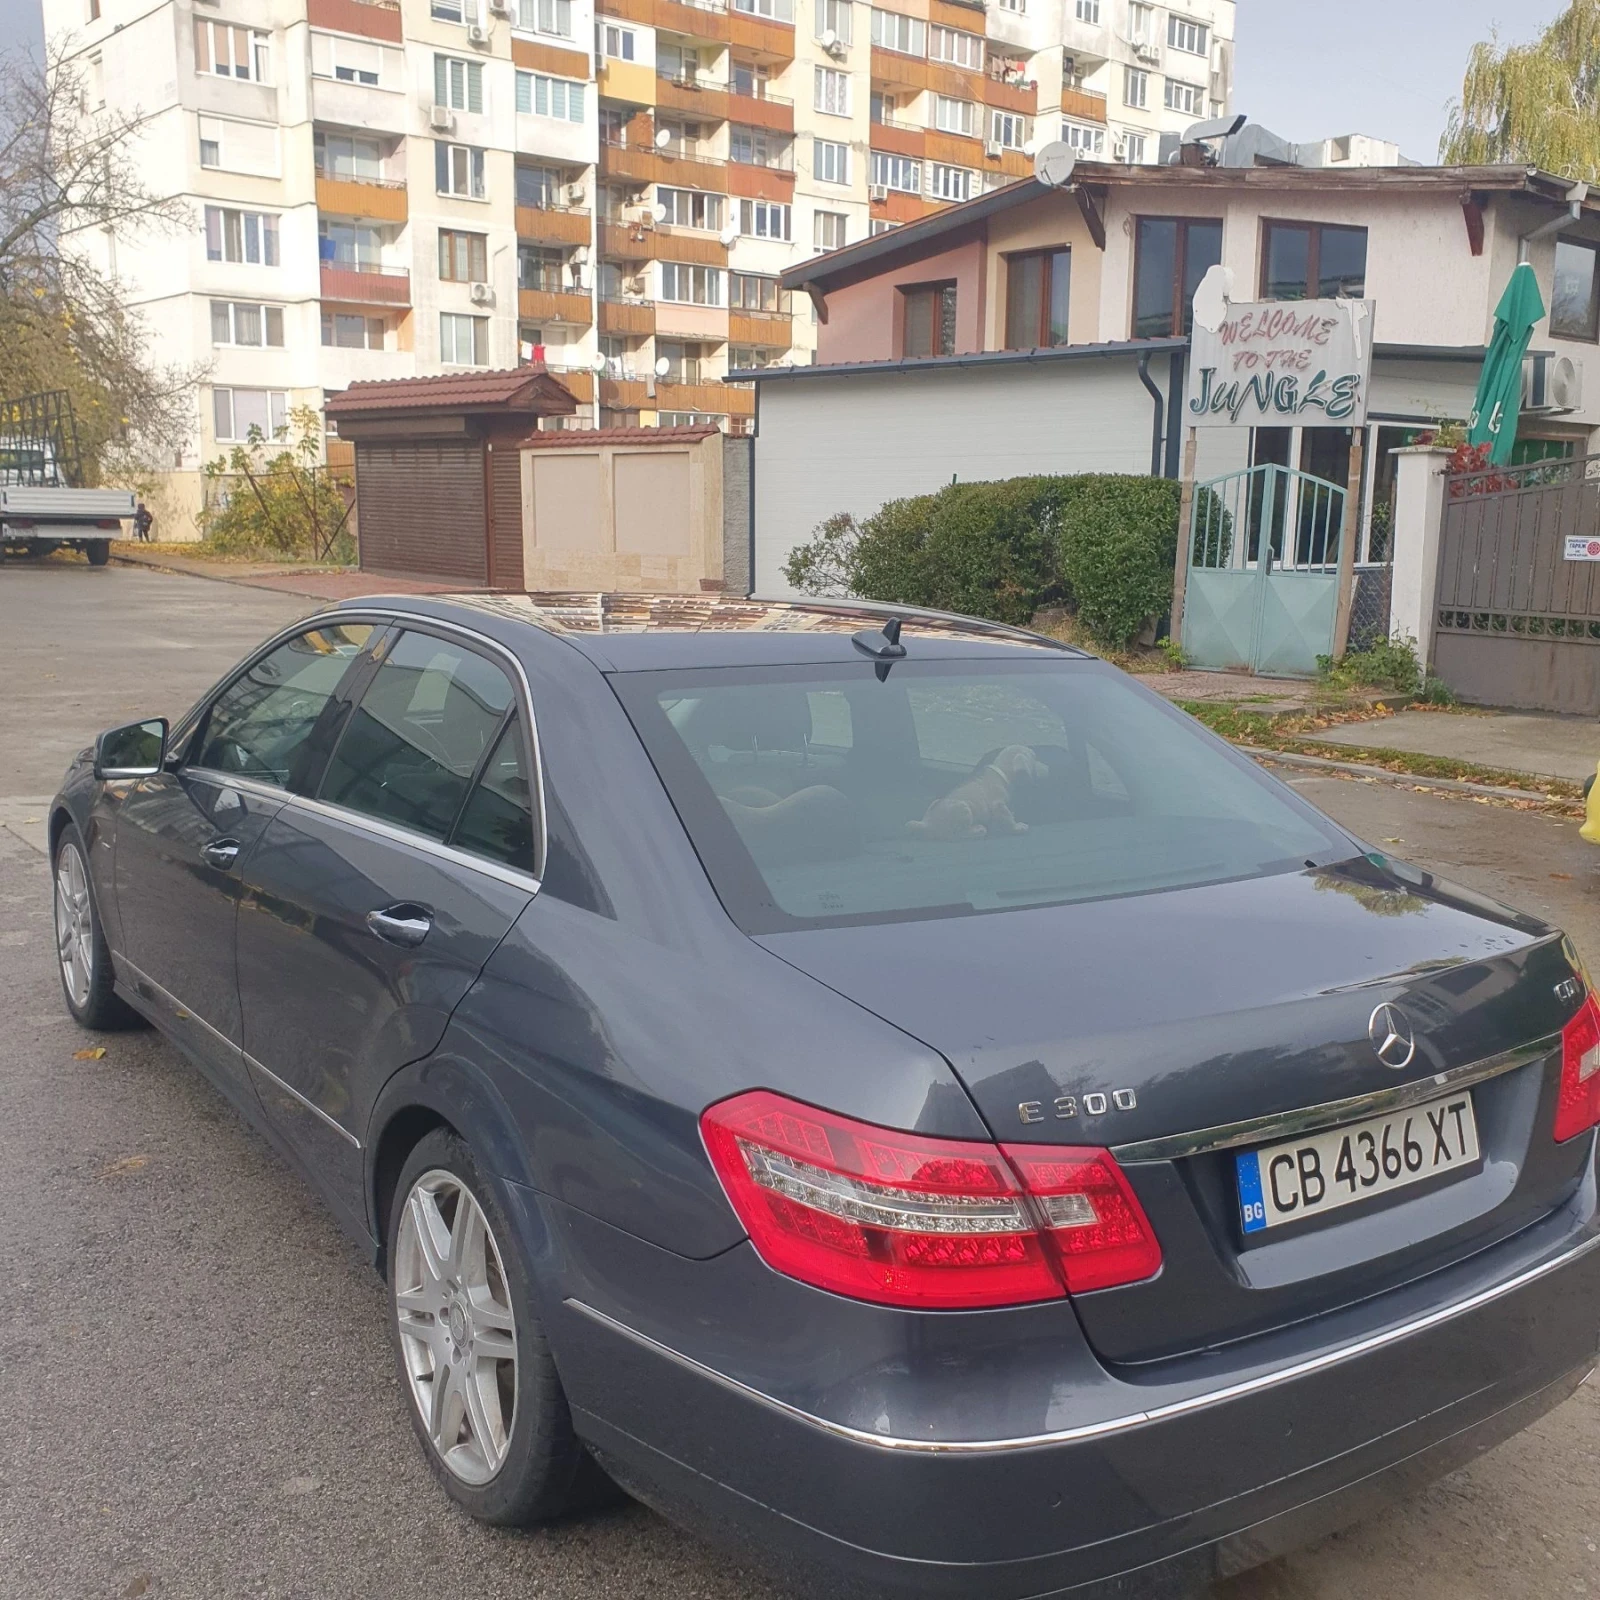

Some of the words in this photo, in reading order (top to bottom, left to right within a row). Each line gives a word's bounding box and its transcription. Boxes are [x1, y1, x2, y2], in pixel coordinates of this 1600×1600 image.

[1218, 308, 1339, 346] WELCOME
[1233, 350, 1259, 372] TO
[1264, 348, 1313, 371] THE
[1018, 1100, 1045, 1125] E
[1053, 1088, 1137, 1120] 300
[1268, 1146, 1326, 1213] CB
[1334, 1116, 1423, 1194] 4366
[1426, 1100, 1468, 1167] XT
[1242, 1201, 1264, 1224] BG
